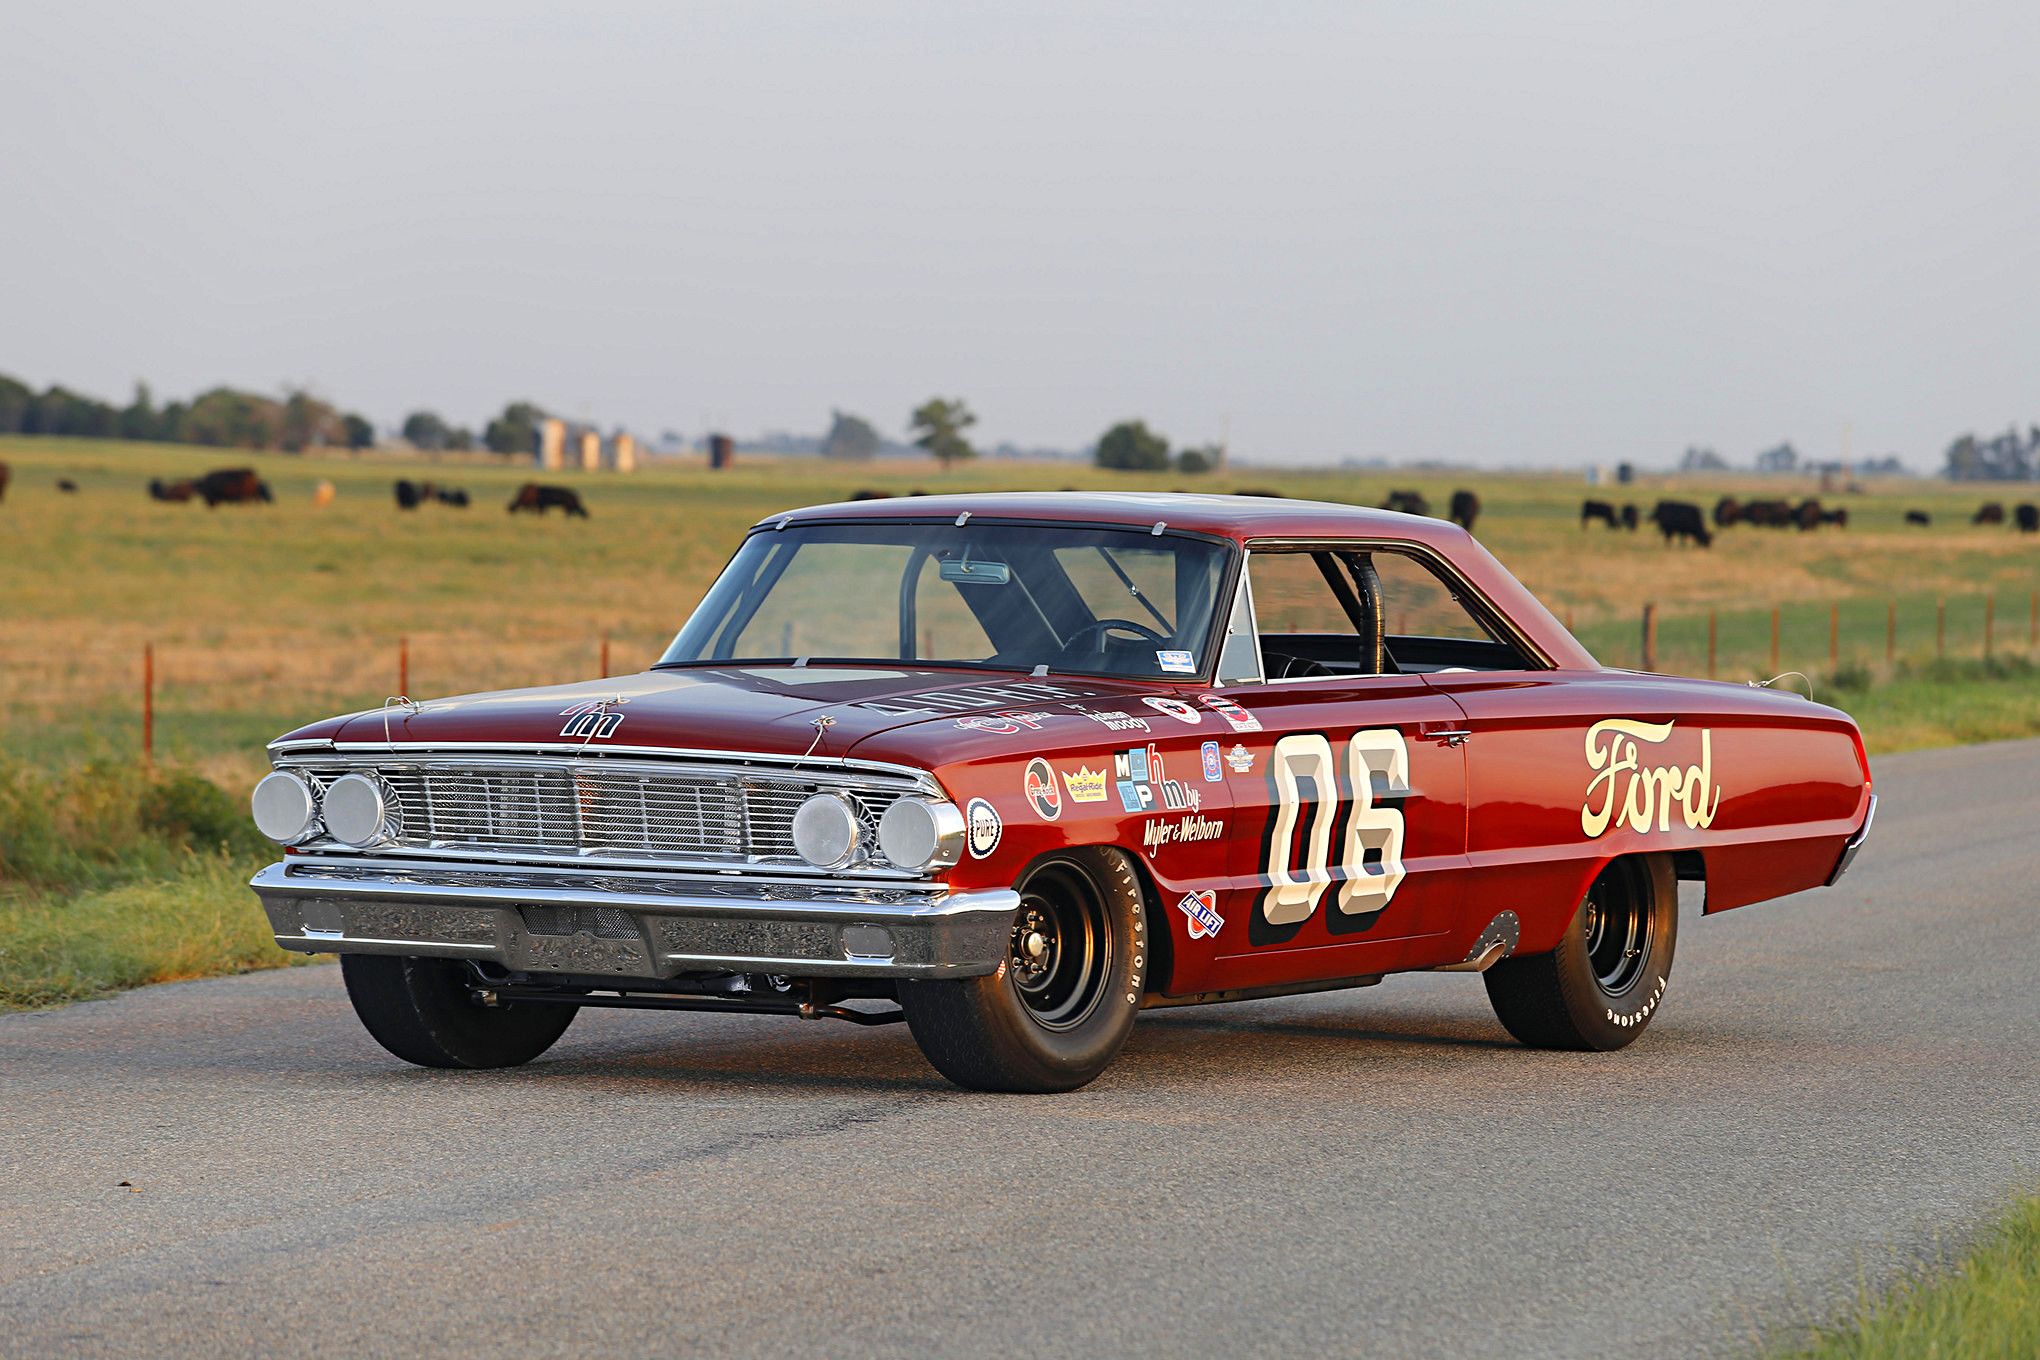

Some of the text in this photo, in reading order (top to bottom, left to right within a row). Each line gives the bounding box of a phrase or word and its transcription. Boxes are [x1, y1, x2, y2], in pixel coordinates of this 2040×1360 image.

[1581, 718, 1720, 838] Ford
[975, 819, 994, 837] PURE
[1263, 728, 1409, 925] 06
[1115, 859, 1145, 1004] Firestone
[1183, 897, 1220, 931] AIR LIFT
[1607, 975, 1667, 1027] Firestone
